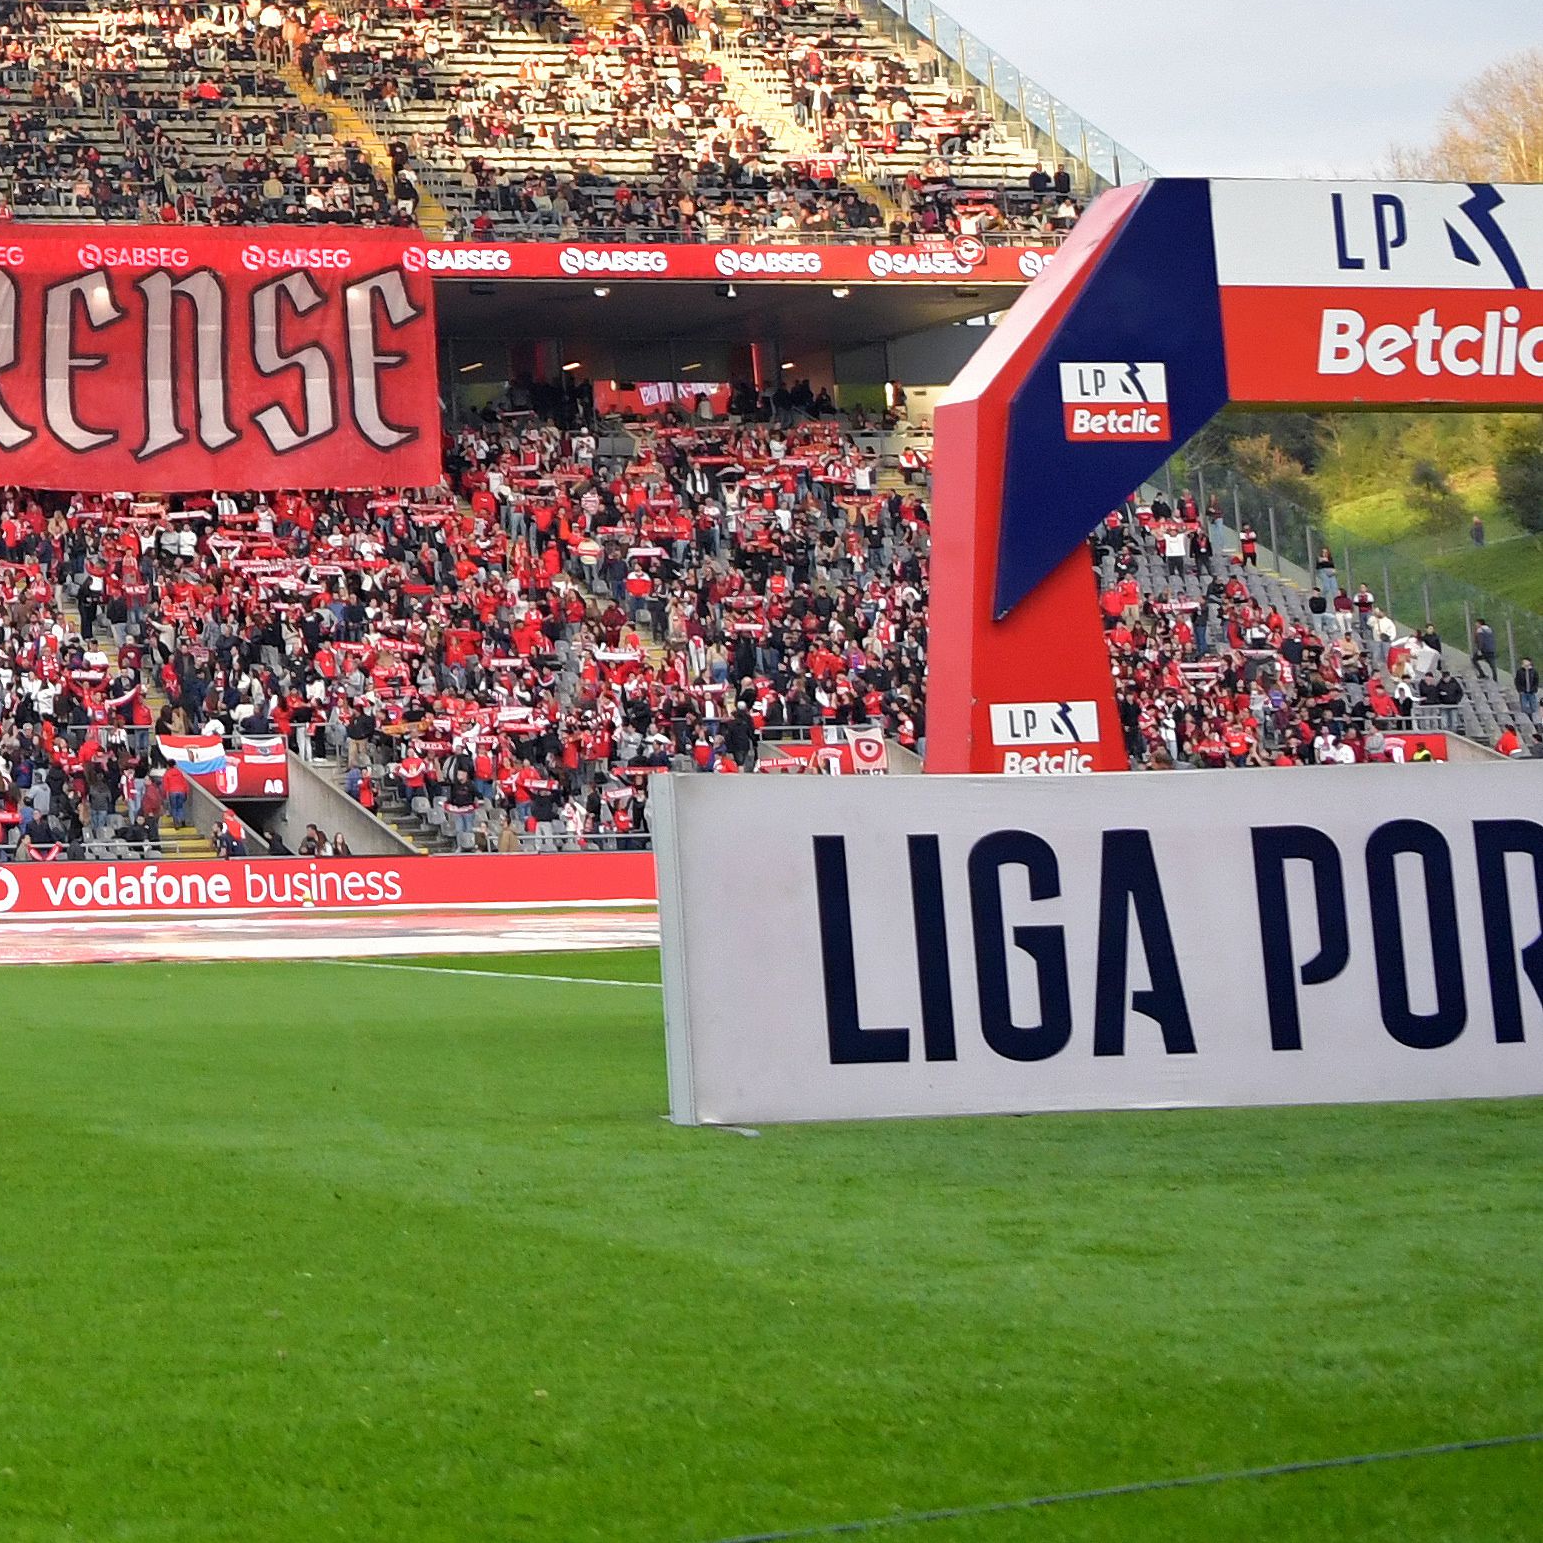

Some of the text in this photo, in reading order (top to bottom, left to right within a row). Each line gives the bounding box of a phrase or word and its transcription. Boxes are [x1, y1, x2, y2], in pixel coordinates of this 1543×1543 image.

[1330, 192, 1408, 272] LP
[104, 246, 189, 269] SABSEG
[267, 248, 351, 270] SABSEG
[426, 249, 512, 272] SABSEG
[584, 250, 668, 274] SABSEG
[739, 251, 822, 274] SABSEG
[1077, 368, 1107, 397] LP
[1071, 407, 1162, 435] Betclic
[1008, 709, 1038, 738] LP
[1002, 748, 1094, 775] Betclic
[42, 863, 402, 906] vodafone business
[812, 828, 1198, 1065] LIGA
